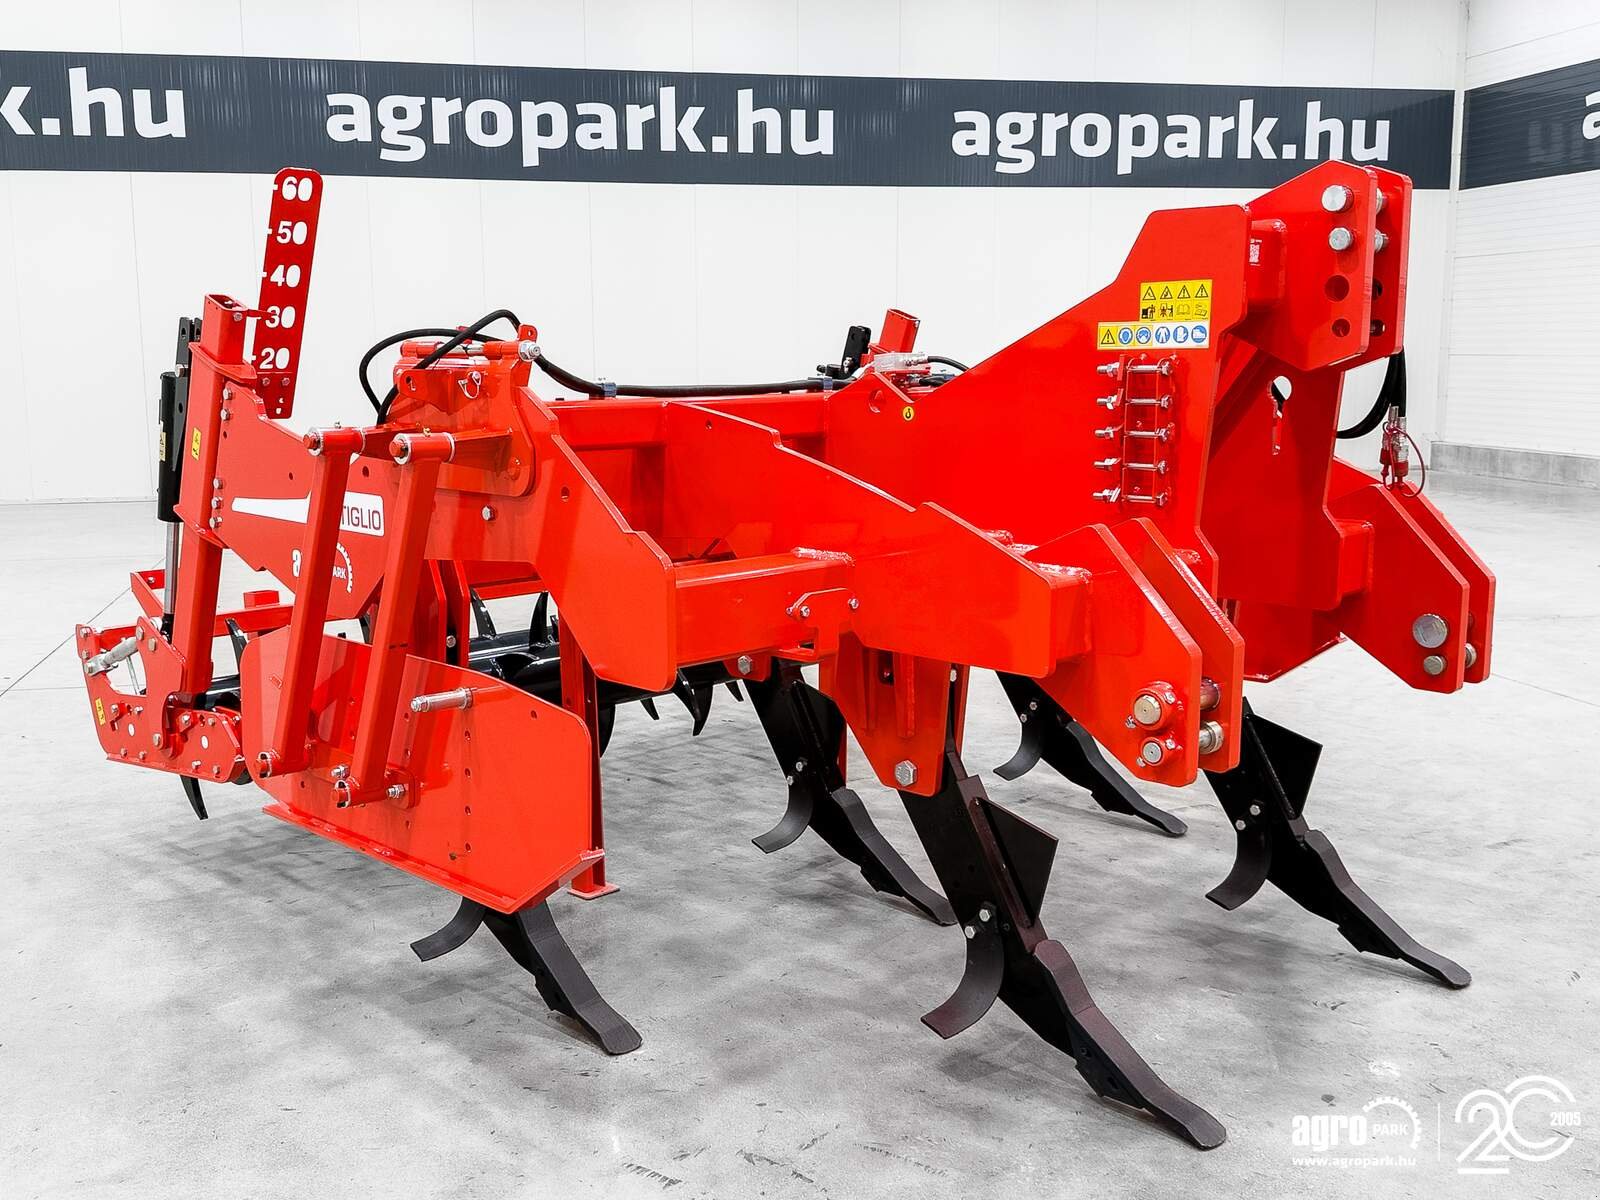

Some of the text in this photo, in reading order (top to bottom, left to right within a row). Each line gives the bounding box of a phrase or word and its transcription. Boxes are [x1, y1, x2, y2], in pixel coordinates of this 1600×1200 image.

[326, 86, 834, 167] agropark.hu
[951, 99, 1390, 175] agropark.hu
[281, 176, 313, 202] 60
[276, 220, 308, 245] 50
[270, 264, 301, 288] 40
[265, 305, 296, 328] 30
[259, 347, 290, 370] 20
